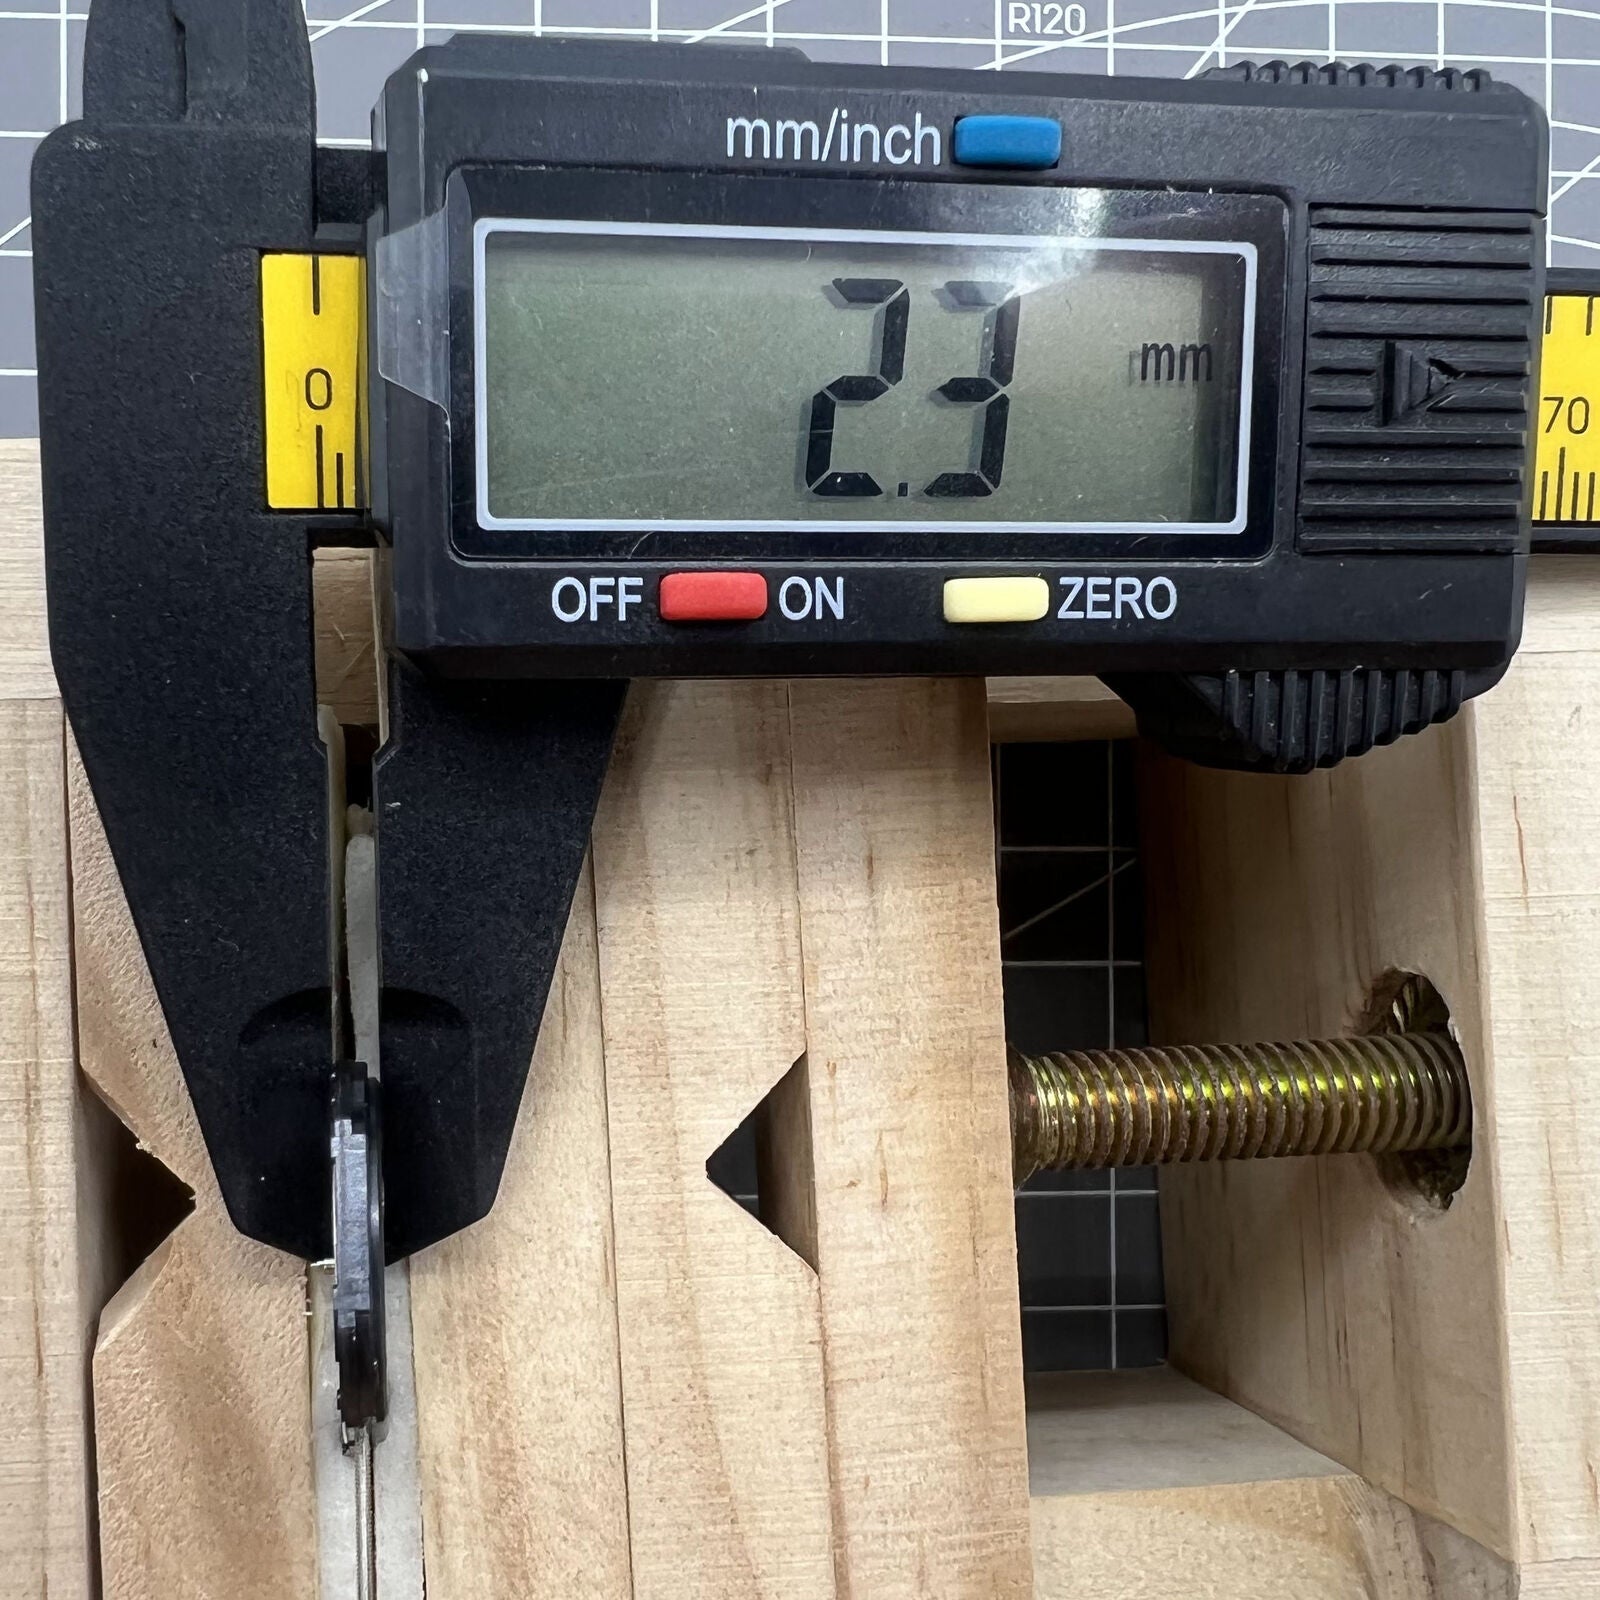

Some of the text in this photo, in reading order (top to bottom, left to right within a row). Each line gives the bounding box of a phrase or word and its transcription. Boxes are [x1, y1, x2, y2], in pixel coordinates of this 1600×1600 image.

[1008, 2, 1086, 36] R120
[726, 106, 941, 166] mm/inch
[305, 367, 333, 411] 0
[805, 278, 1213, 498] 2.3 mm
[1543, 396, 1590, 435] 70
[551, 576, 844, 623] OFF ON
[1057, 576, 1178, 620] ZERO
